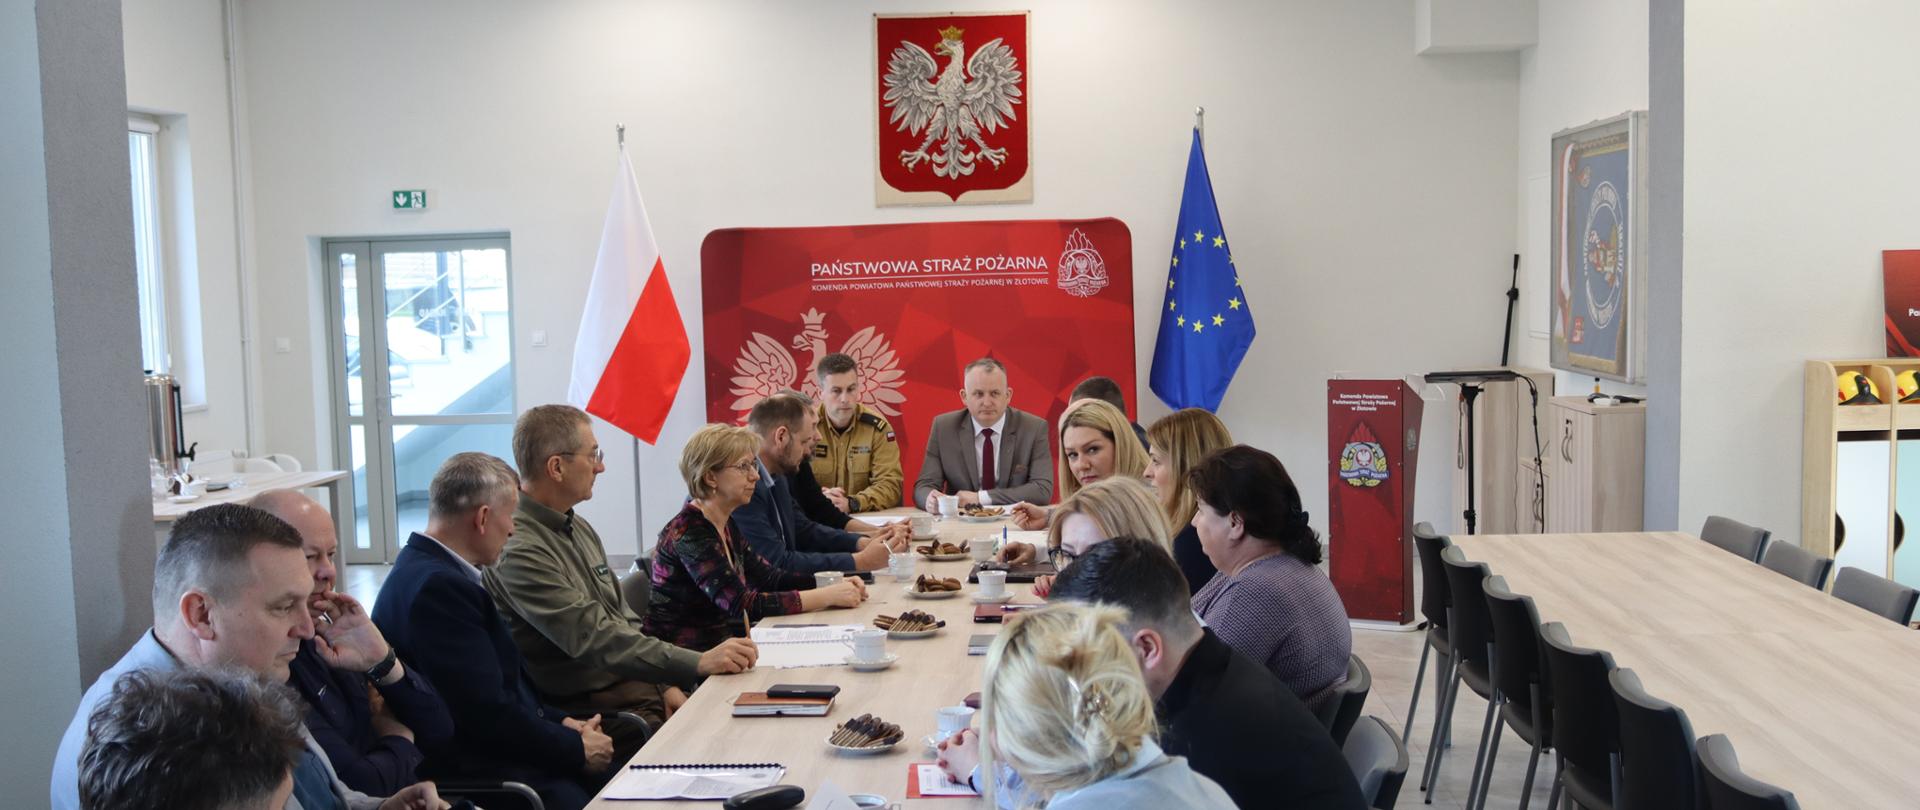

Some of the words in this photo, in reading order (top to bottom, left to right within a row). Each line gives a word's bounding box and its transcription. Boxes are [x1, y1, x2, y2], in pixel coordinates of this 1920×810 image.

[811, 259, 919, 276] PAŃSTWOWA
[922, 256, 972, 273] STRAŻ
[975, 254, 1048, 270] POŻARNA
[811, 283, 848, 291] KOMENDA
[849, 282, 894, 290] POWIATOWA
[895, 280, 943, 288] PAŃSTWOWEJ
[944, 279, 969, 287] STRAŻY
[971, 278, 1005, 286] POŻARNEJ
